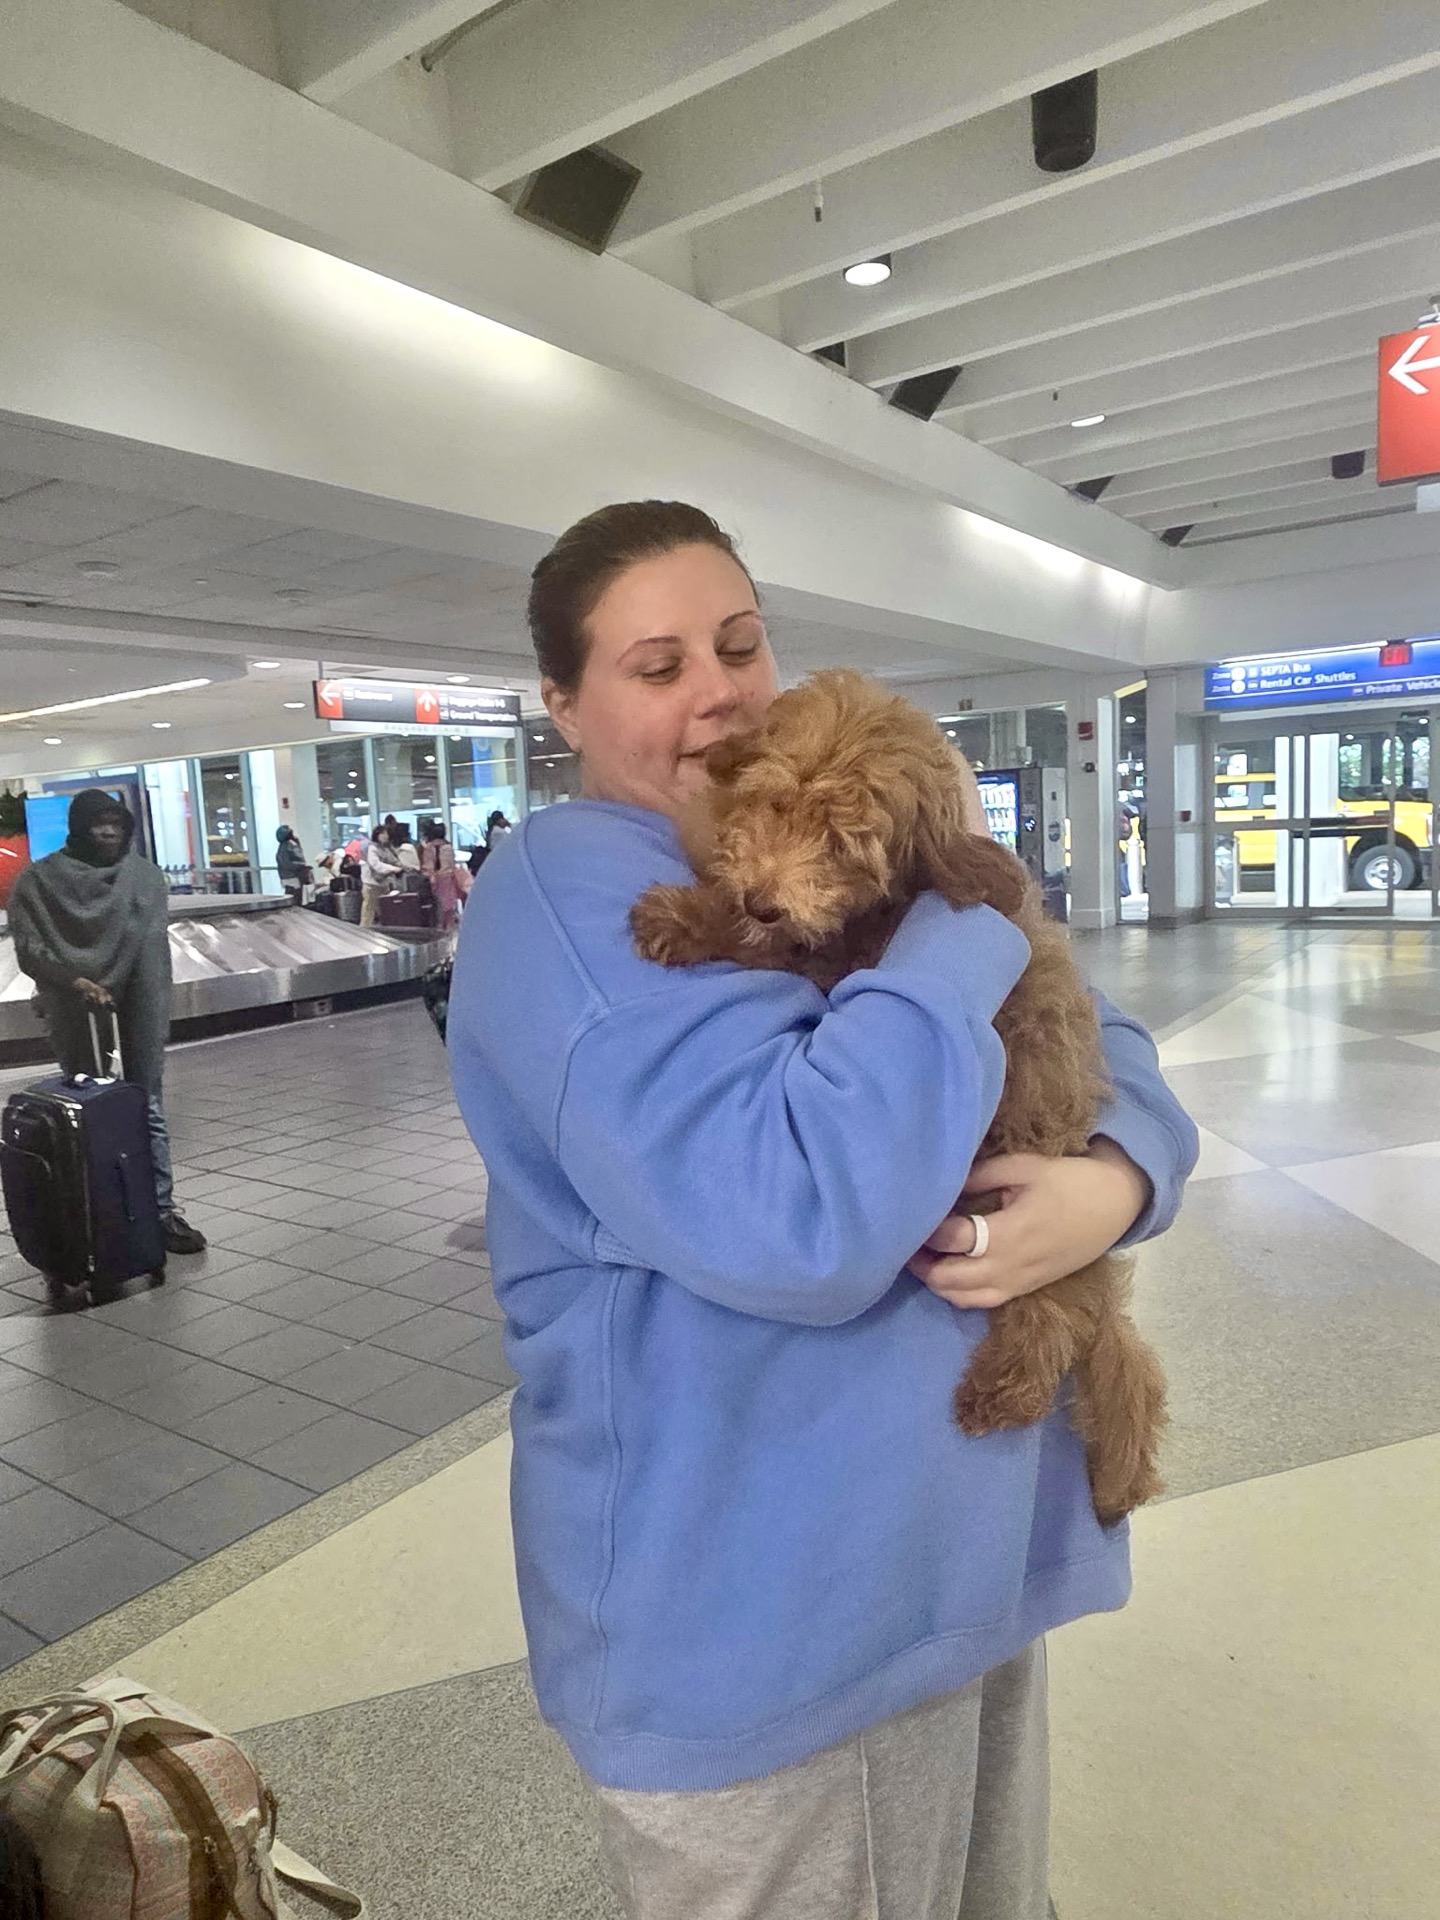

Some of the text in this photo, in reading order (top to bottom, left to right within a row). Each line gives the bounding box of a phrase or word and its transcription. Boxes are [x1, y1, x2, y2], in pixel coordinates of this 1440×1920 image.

[1261, 664, 1291, 676] SEPTA
[1293, 662, 1312, 673] Bus
[1260, 677, 1292, 689] Rental
[1294, 676, 1312, 686] Car
[1314, 671, 1356, 684] Shuttles
[1365, 684, 1403, 694] Private
